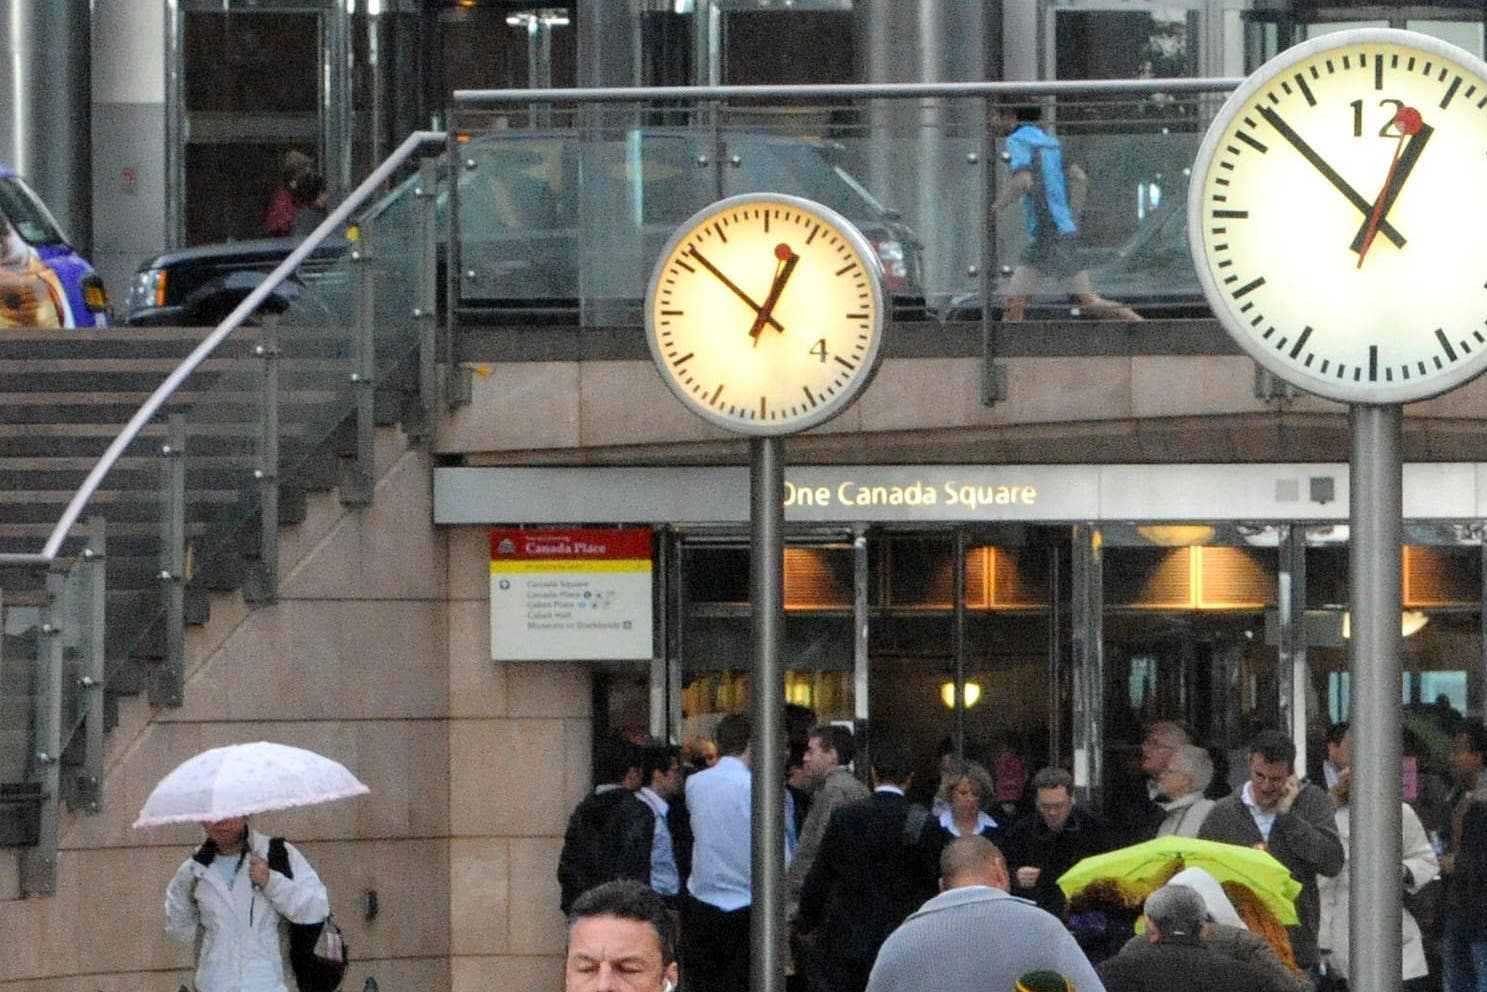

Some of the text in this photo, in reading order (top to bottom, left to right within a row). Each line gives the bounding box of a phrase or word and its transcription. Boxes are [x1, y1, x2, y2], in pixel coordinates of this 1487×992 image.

[1349, 98, 1405, 138] 12
[808, 338, 829, 364] 4
[837, 480, 938, 507] Canada
[944, 480, 1038, 511] Square
[525, 542, 606, 554] Canada Place
